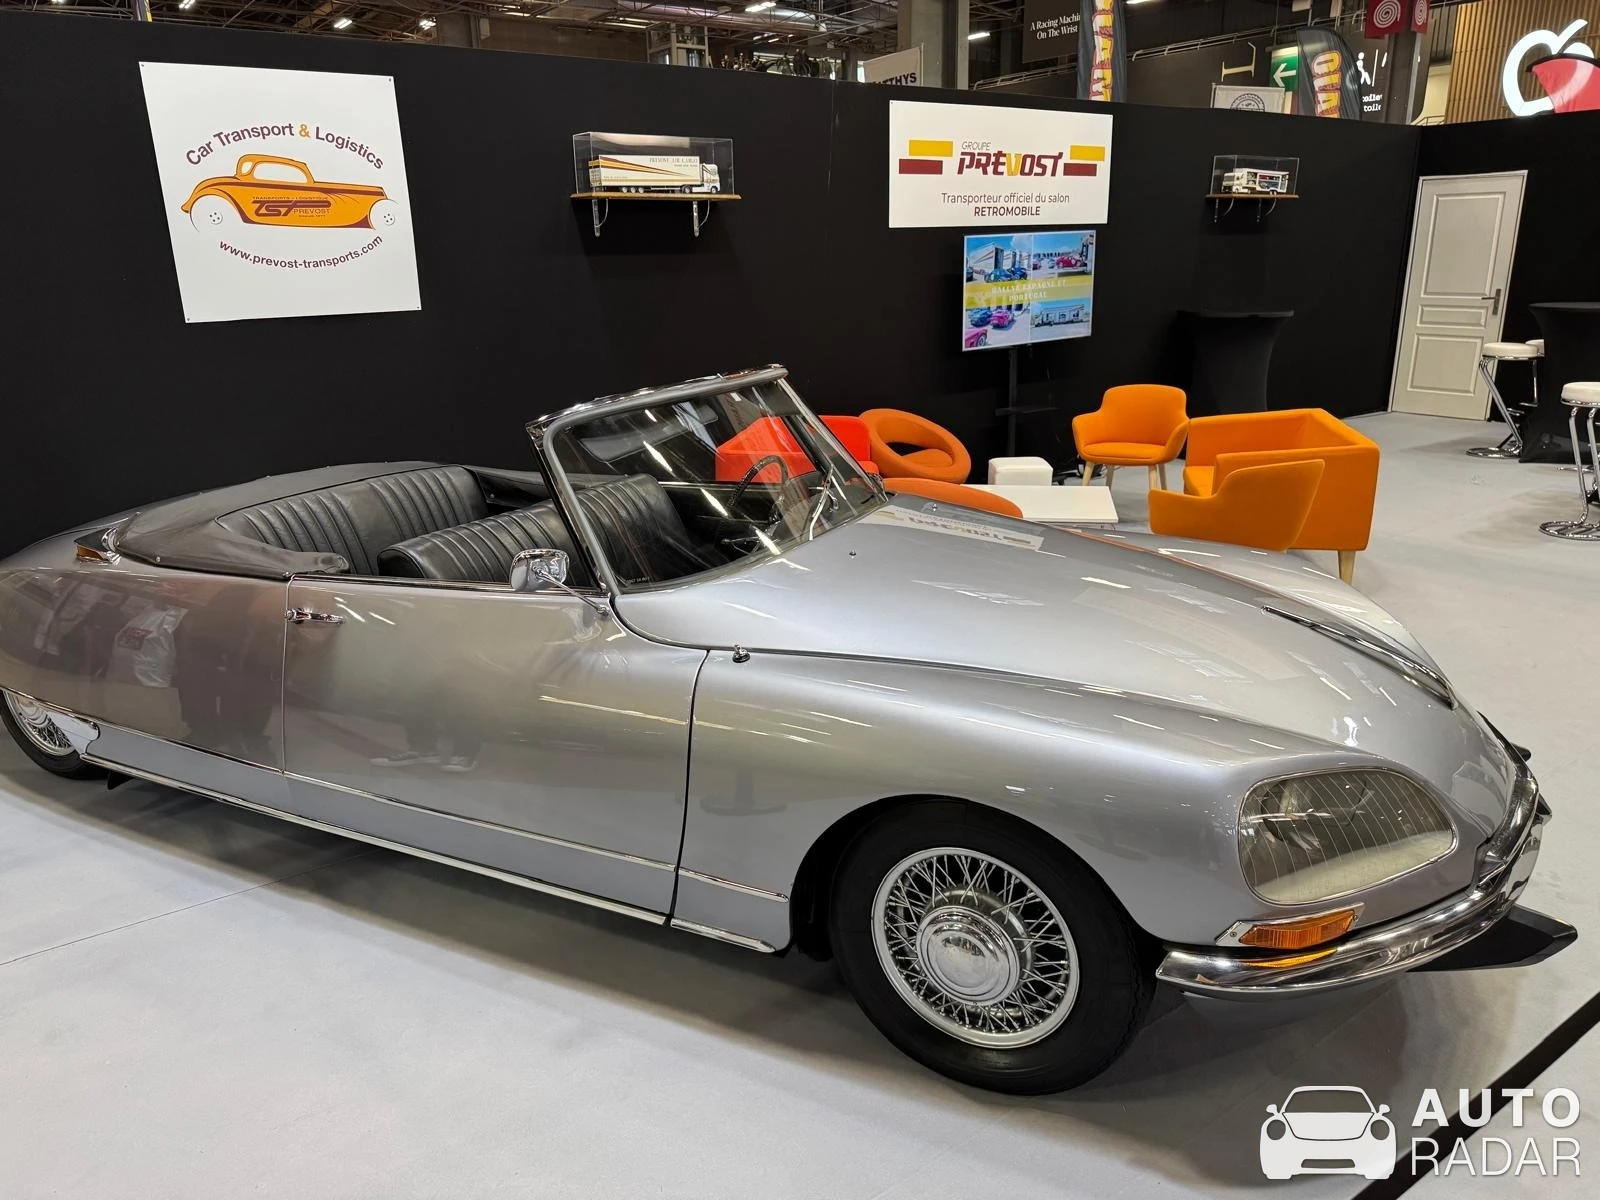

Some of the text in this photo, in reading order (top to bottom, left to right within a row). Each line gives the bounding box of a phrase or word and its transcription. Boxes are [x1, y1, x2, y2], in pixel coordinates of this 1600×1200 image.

[1030, 22, 1036, 31] A
[1036, 19, 1059, 30] Racing
[1036, 24, 1078, 40] On The Wrist
[186, 123, 384, 169] Car Transport & Logistics
[961, 141, 991, 151] GROUPE
[941, 192, 1070, 205] Transporteur officiel du salon
[973, 206, 1041, 217] RETROMOBILE
[220, 236, 383, 269] www.prevost-transports.com
